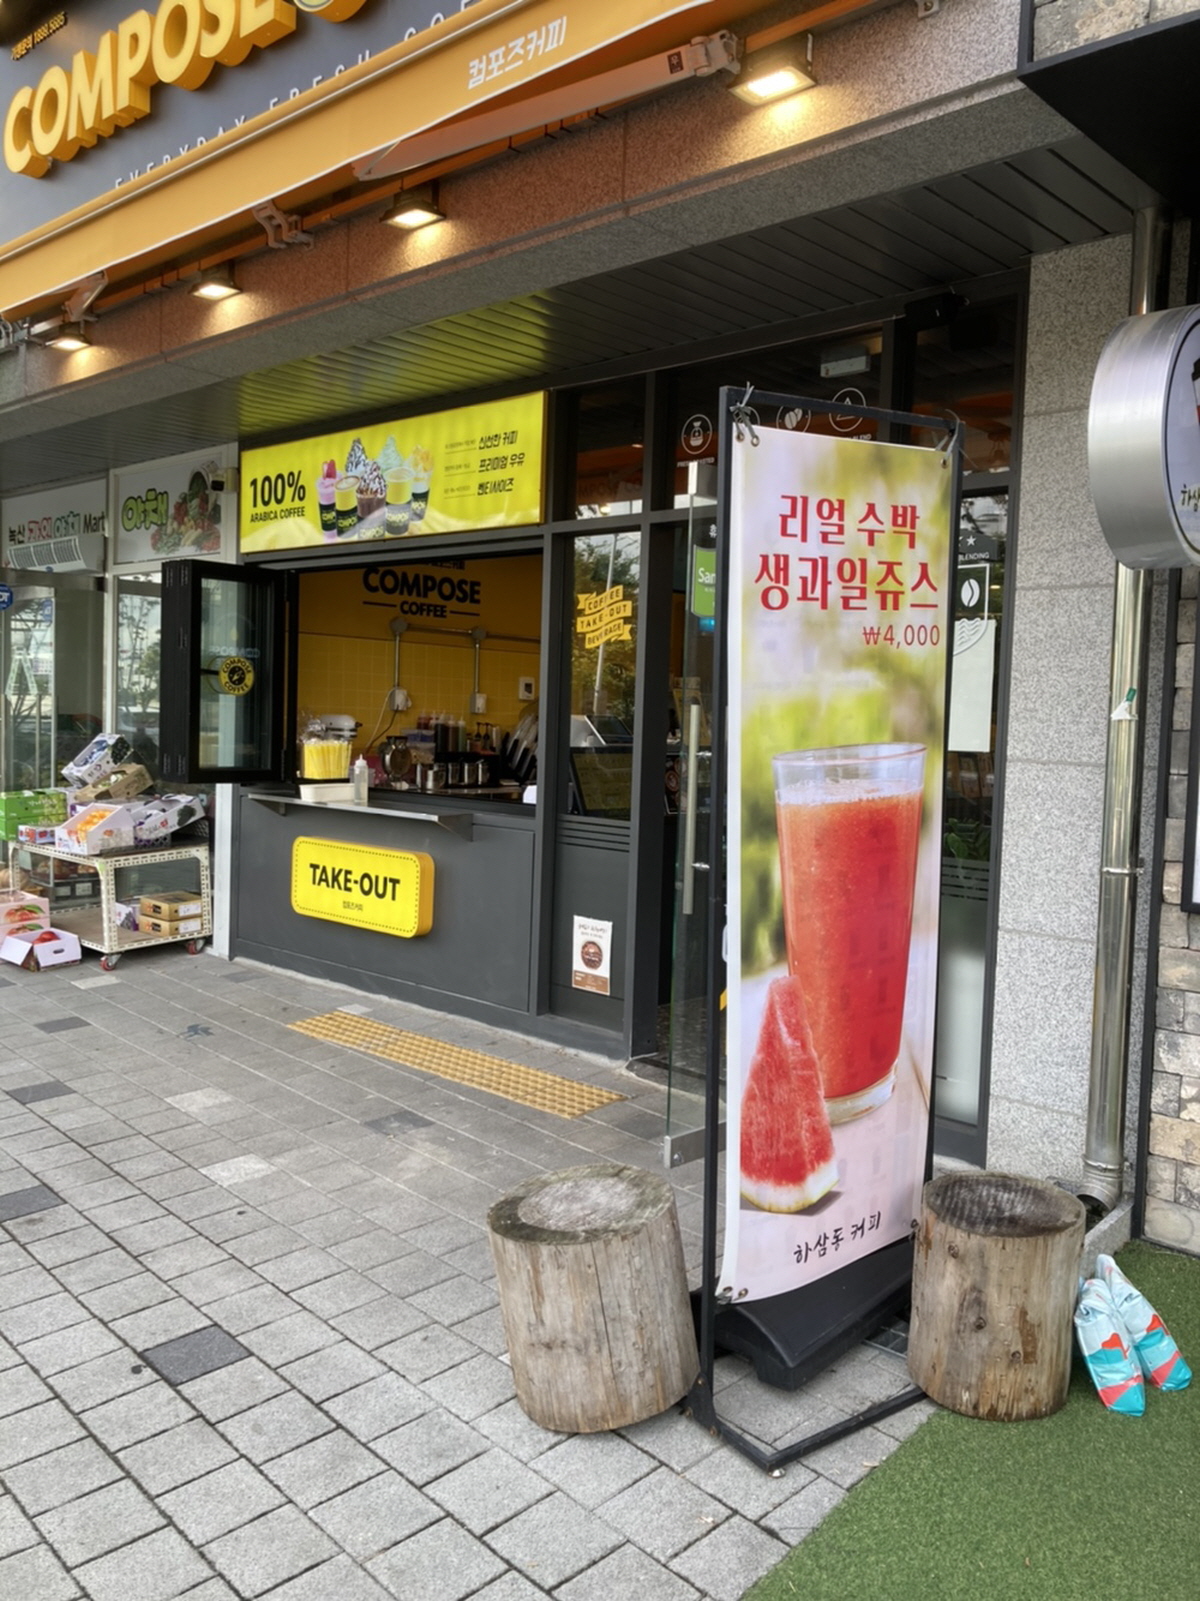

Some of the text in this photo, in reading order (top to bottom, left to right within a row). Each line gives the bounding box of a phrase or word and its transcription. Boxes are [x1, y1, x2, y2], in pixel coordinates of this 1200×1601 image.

[467, 16, 567, 90] 컴포즈커피
[502, 430, 518, 446] 커피
[478, 455, 508, 473] 프리미엄
[509, 452, 525, 467] 우유
[250, 470, 306, 508] 100%
[83, 511, 106, 534] Mart
[122, 488, 169, 532] 야채
[250, 506, 306, 523] ARABICA COFFEE
[779, 495, 920, 549] 리얼 수박
[362, 566, 481, 604] COMPOSE
[754, 553, 939, 611] 생과일쥬스
[399, 600, 447, 618] COFFEE
[588, 588, 621, 611] COFFEE
[580, 604, 628, 630] TAKE-OUT
[862, 624, 940, 649] ₩4,000
[222, 658, 252, 674] COMPOSE
[224, 681, 249, 693] COFFEE
[309, 863, 401, 902] TAKE-OUT
[793, 1211, 882, 1264] 하삼동 커피
